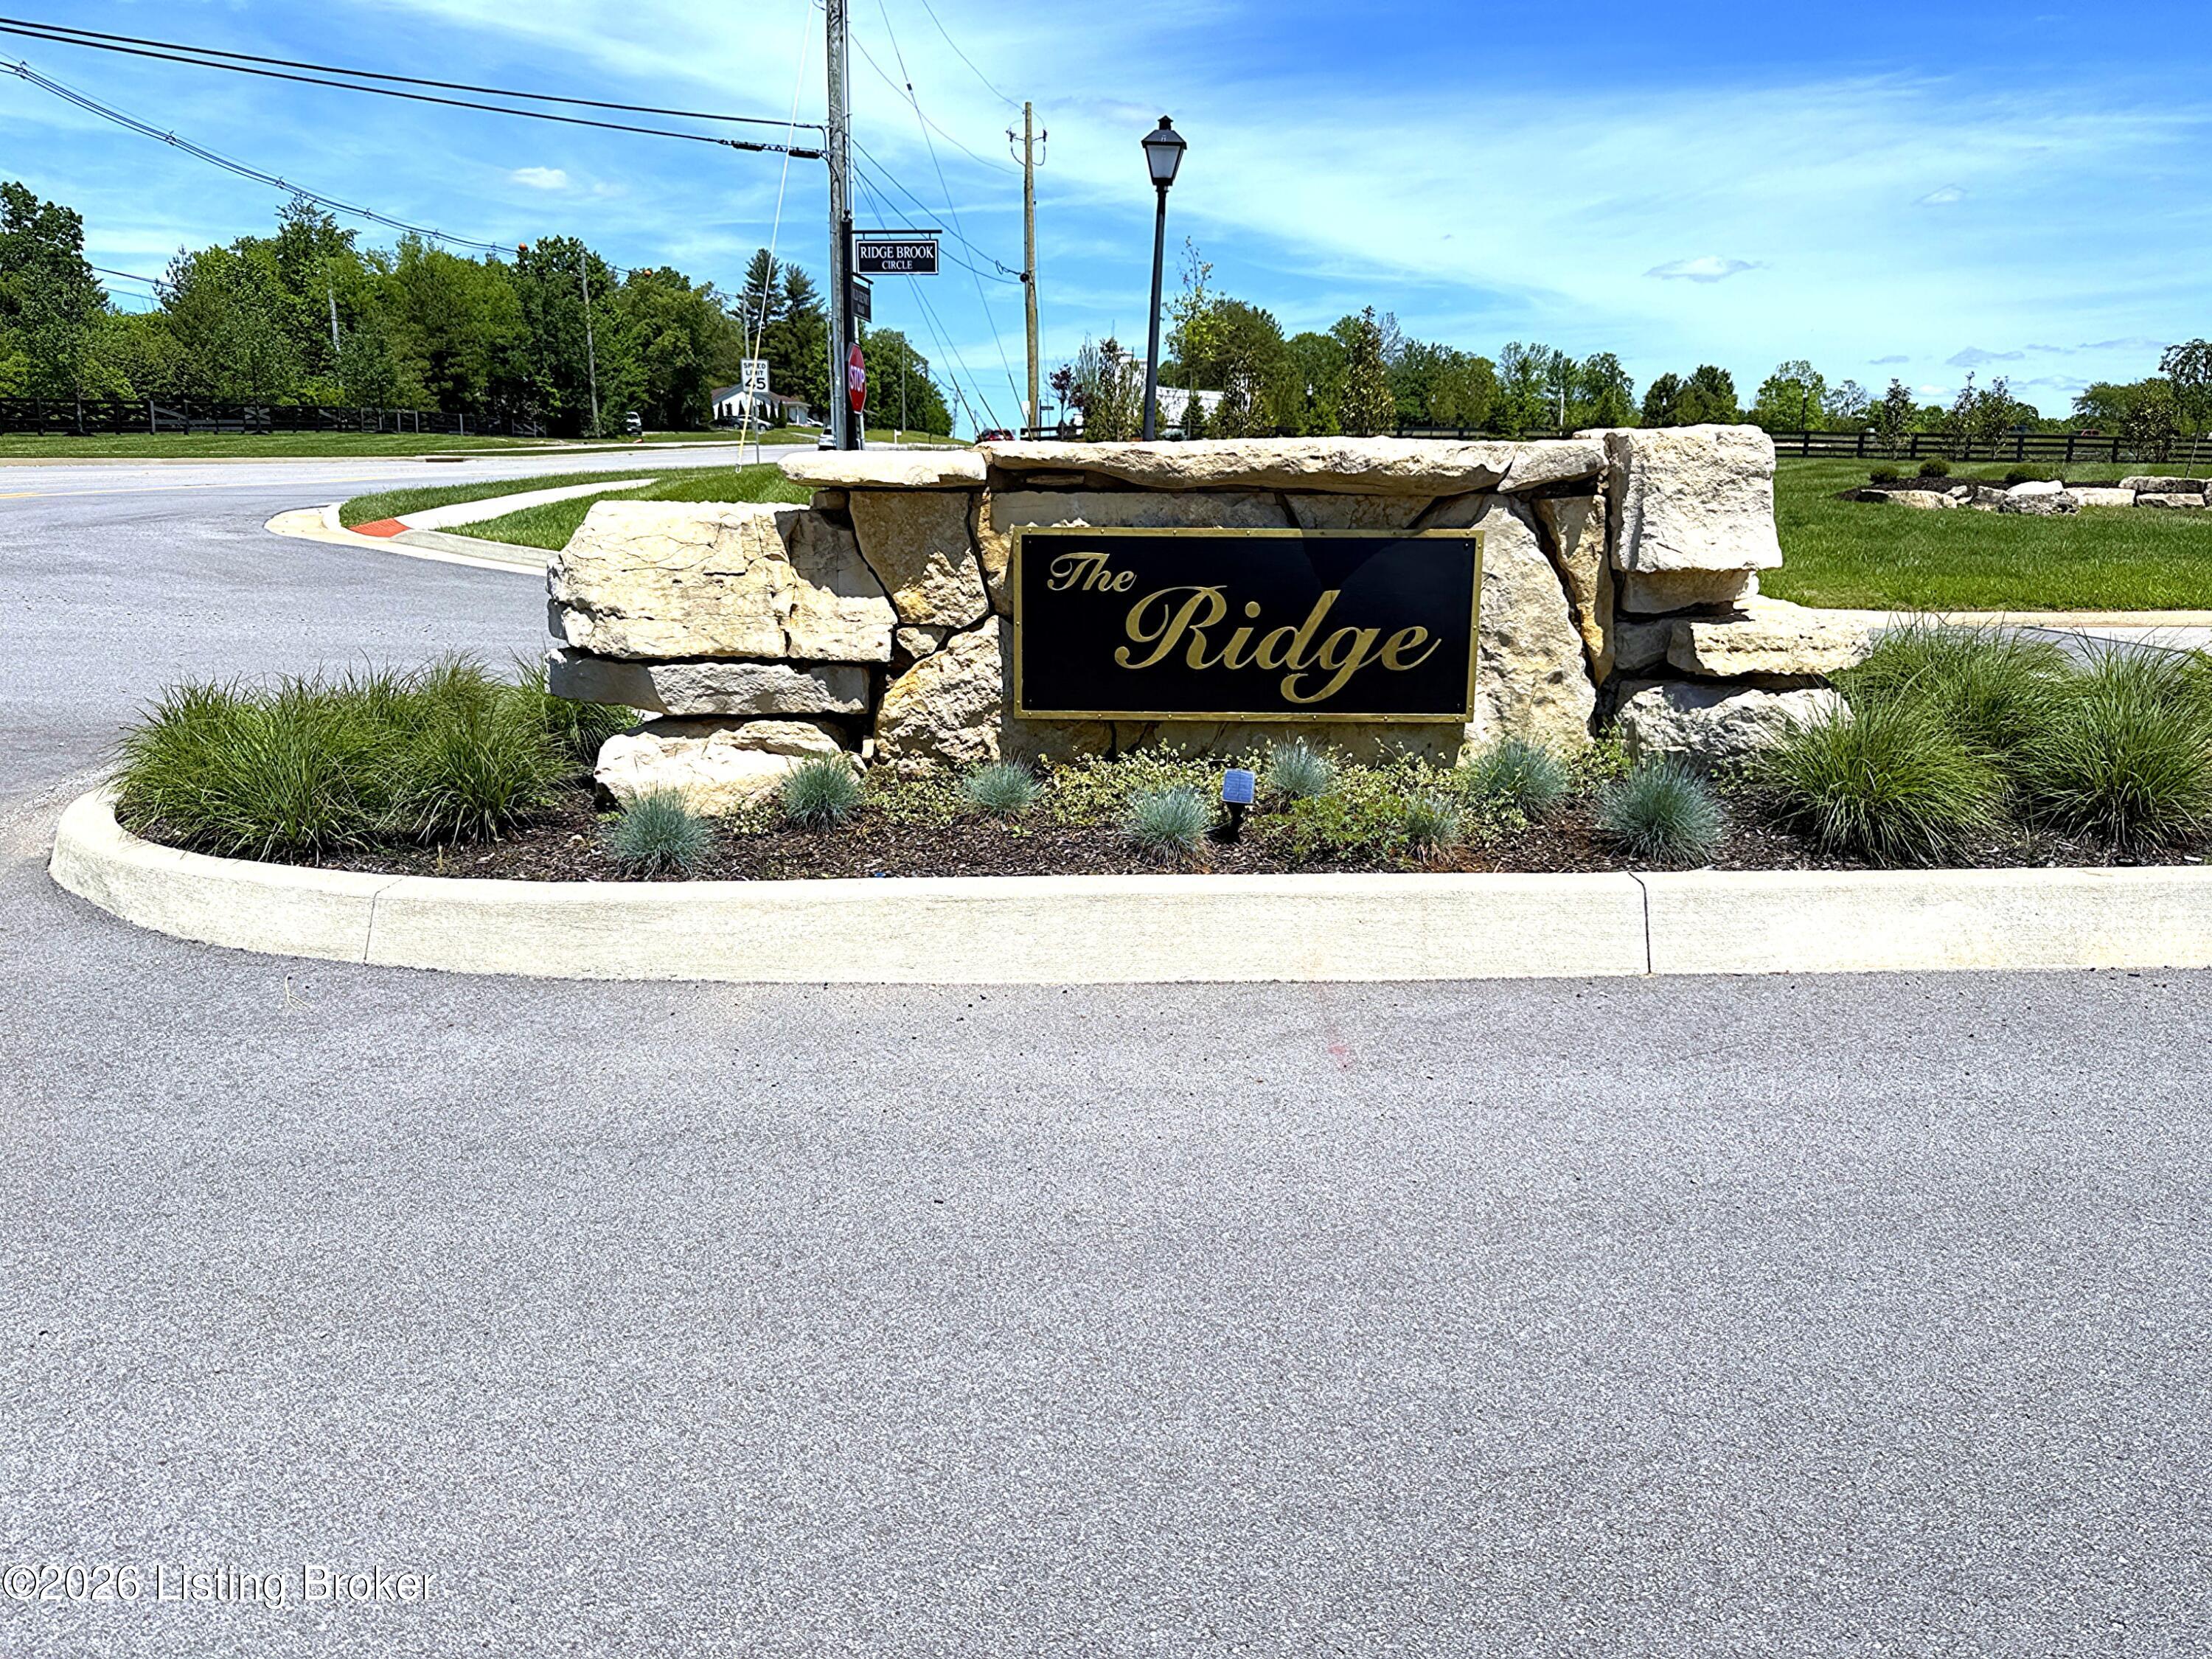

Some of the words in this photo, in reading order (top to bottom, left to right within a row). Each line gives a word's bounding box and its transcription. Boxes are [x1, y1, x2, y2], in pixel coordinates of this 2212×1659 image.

[860, 246, 894, 259] RIDGE
[897, 246, 934, 259] BROOK
[882, 260, 913, 270] CIRCLE
[745, 377, 766, 390] 45
[850, 365, 865, 392] STOP
[1047, 552, 1137, 591] The
[1114, 585, 1442, 704] Ridge
